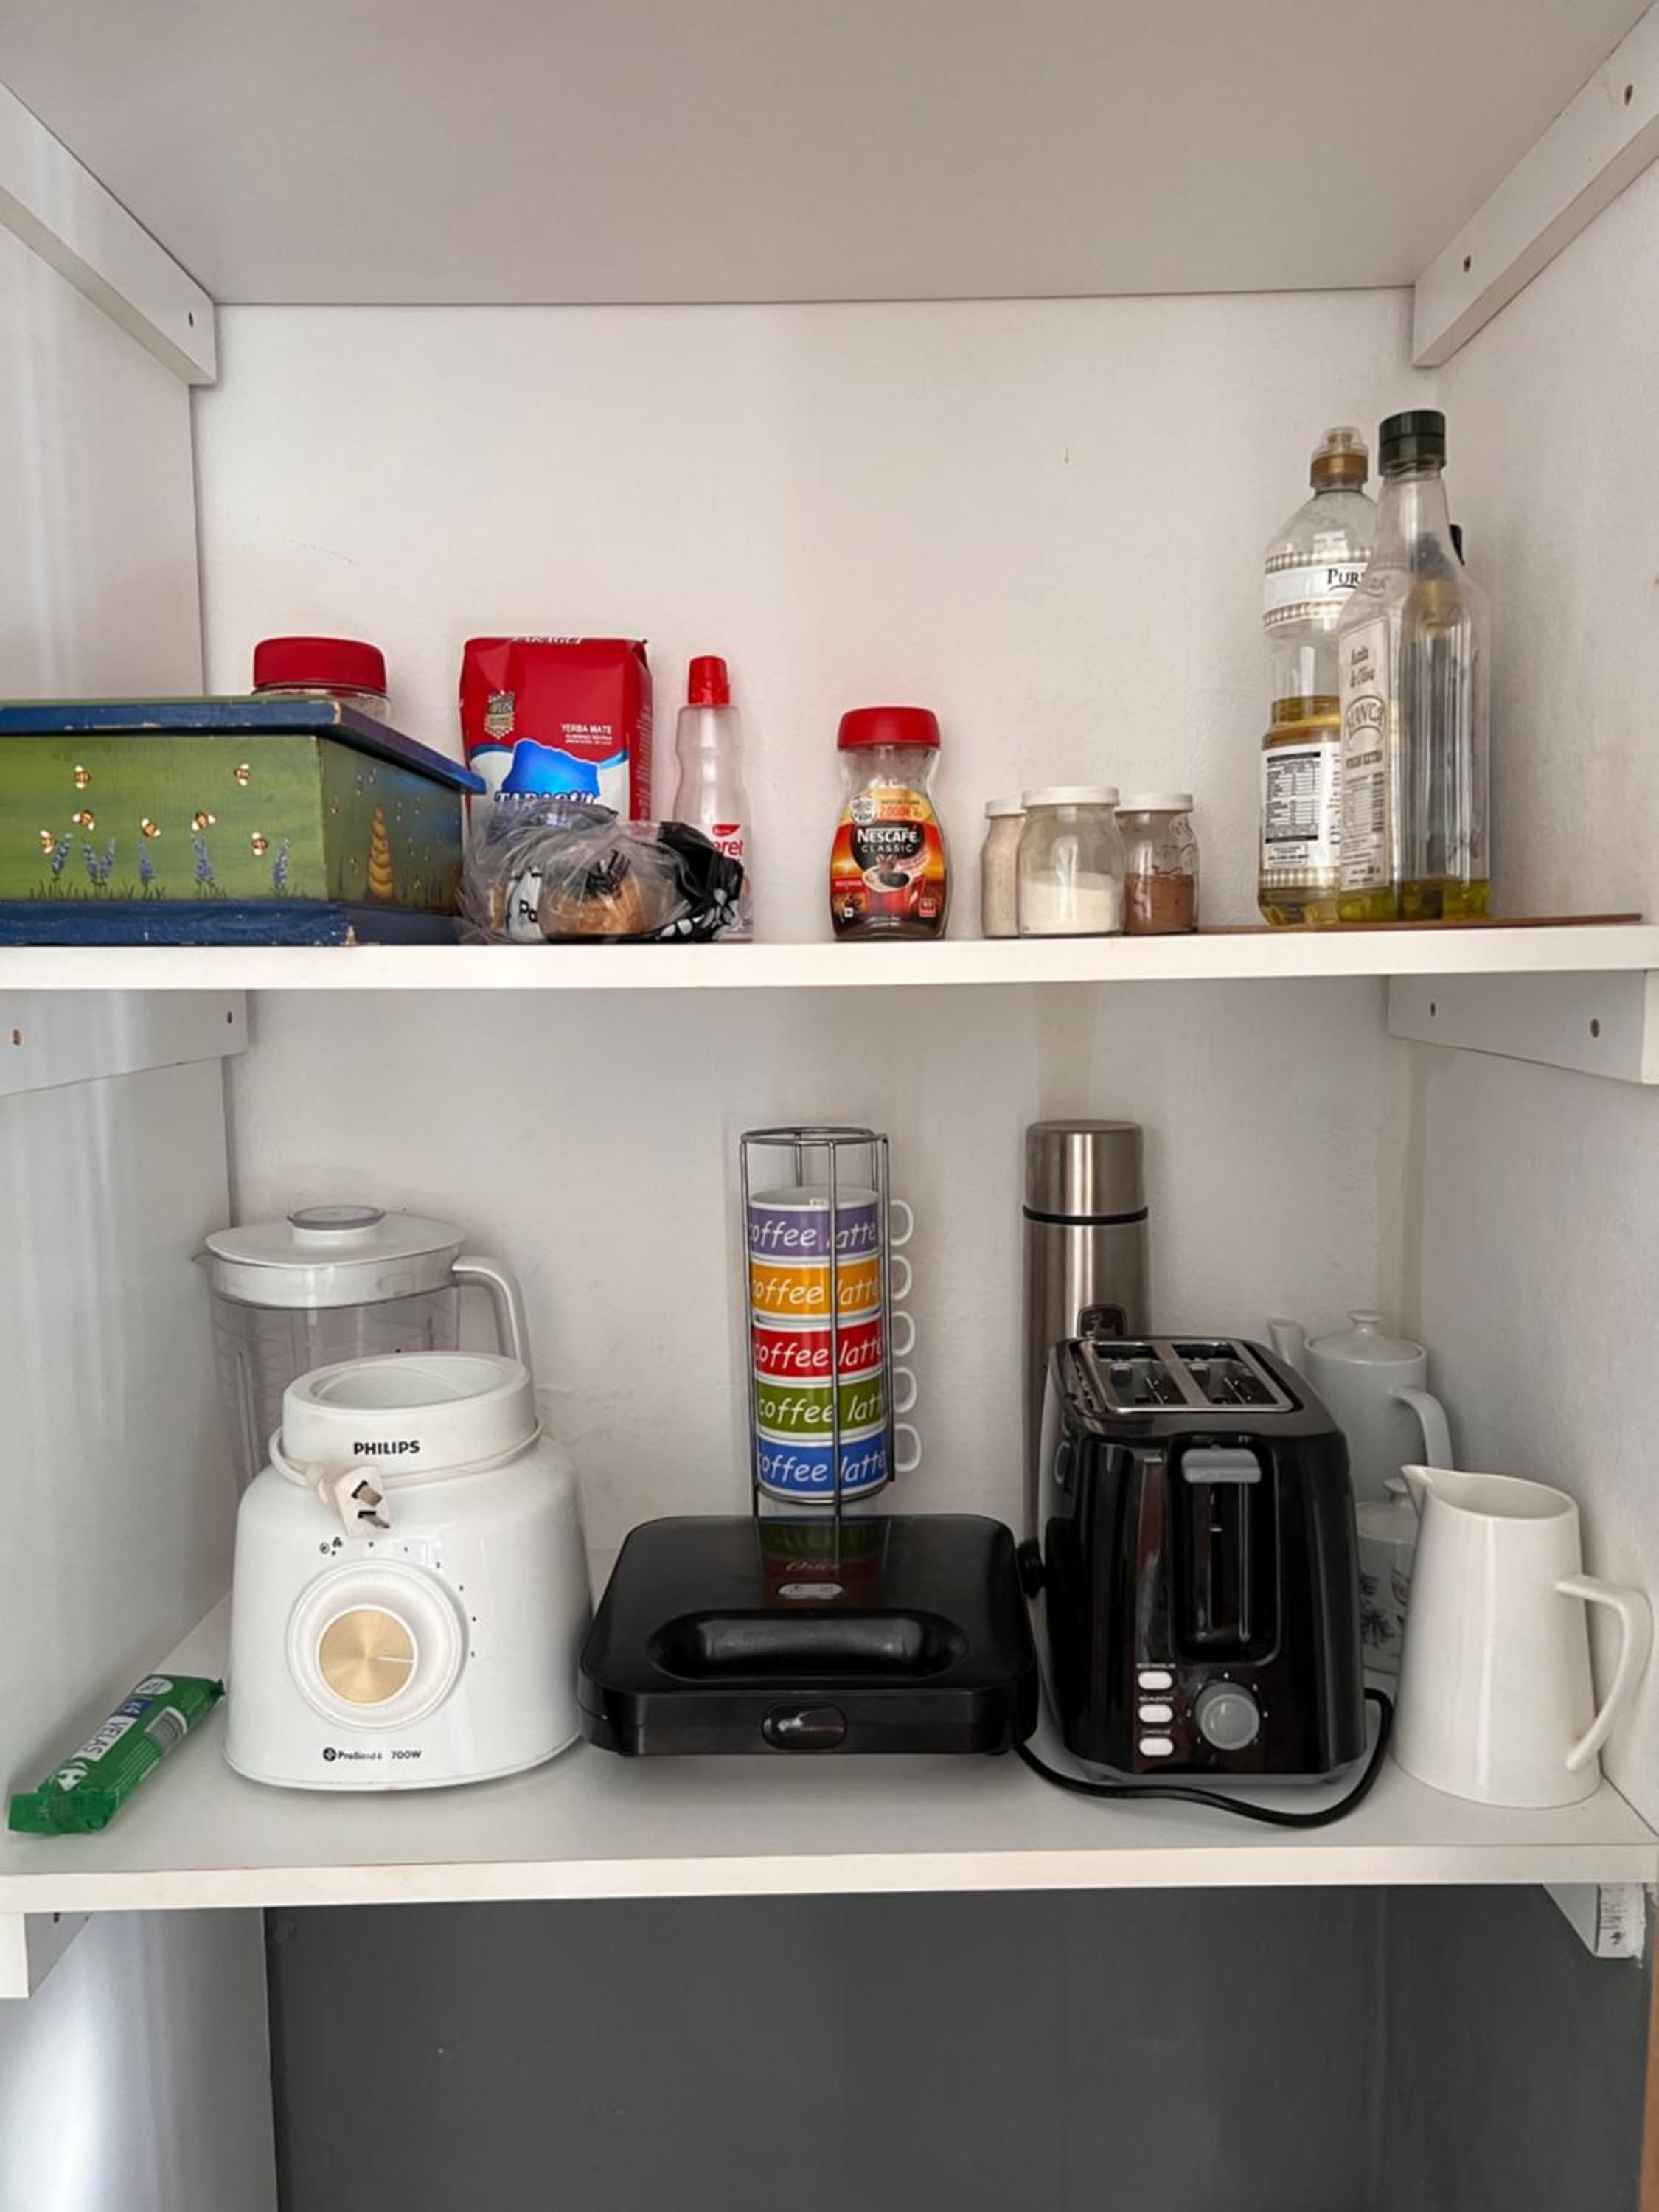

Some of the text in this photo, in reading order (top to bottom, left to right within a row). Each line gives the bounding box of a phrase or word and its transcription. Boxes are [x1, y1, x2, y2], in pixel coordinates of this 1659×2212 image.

[562, 724, 611, 734] YERBA MATE
[861, 844, 914, 853] CLASSIC
[353, 1440, 420, 1455] PHILIPS
[83, 1719, 128, 1755] VELAS
[391, 1750, 422, 1760] 700W
